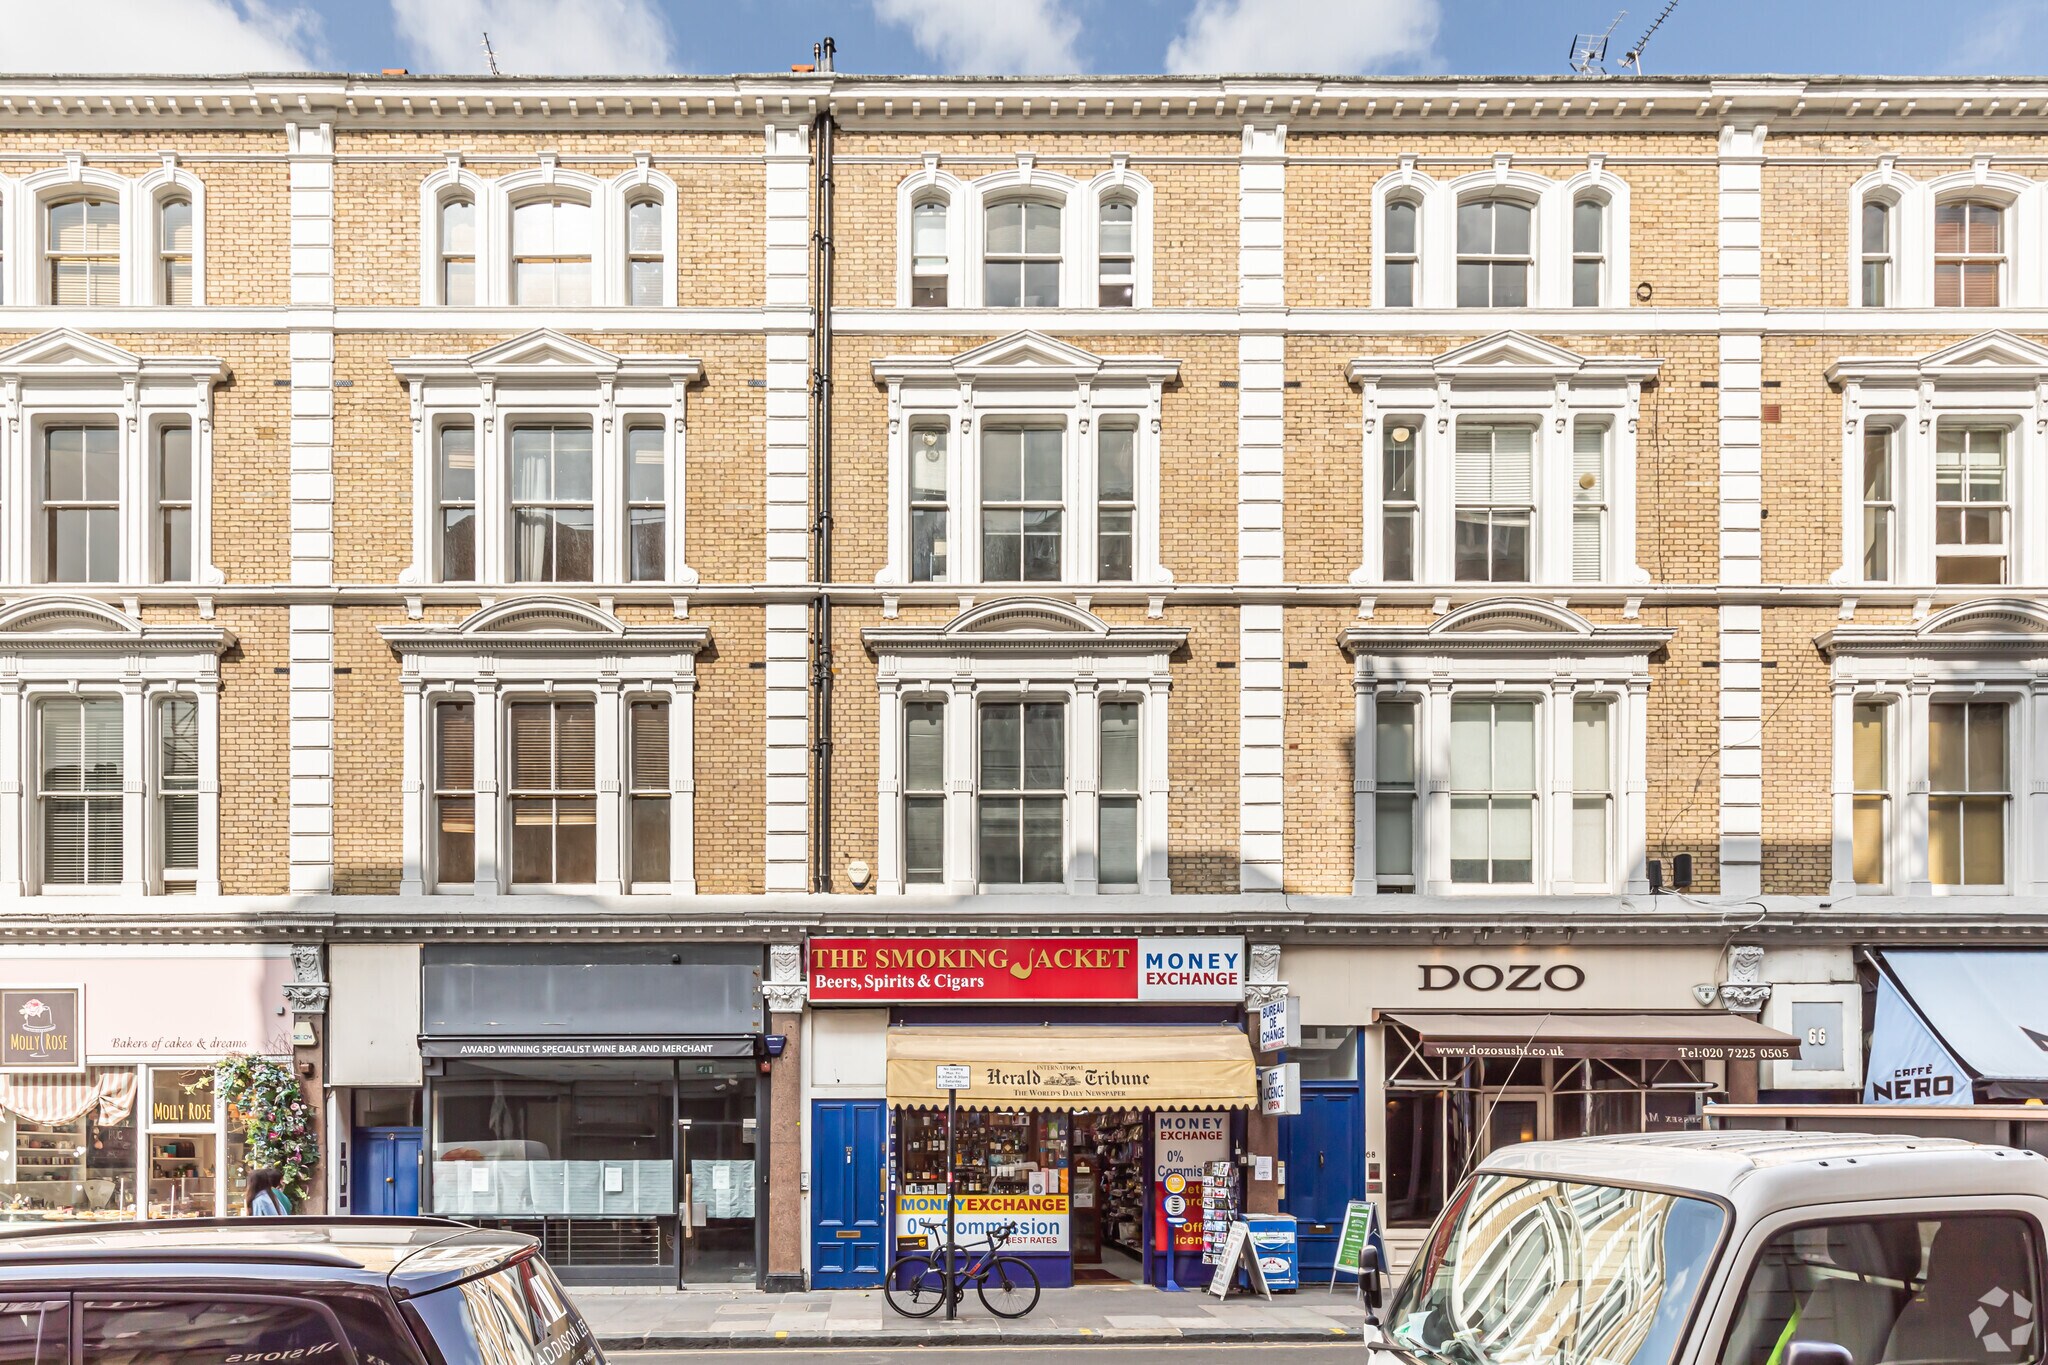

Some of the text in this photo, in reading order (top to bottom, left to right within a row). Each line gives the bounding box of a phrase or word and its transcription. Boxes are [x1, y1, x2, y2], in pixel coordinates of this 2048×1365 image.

[811, 948, 1130, 980] THE SMOKING JACKET
[1146, 953, 1238, 970] MONEY
[815, 974, 984, 992] Beers, Spirits & Cigars
[1146, 972, 1238, 985] EXCHANGE
[1418, 964, 1585, 992] DOZO
[1263, 1001, 1284, 1018] BUREAU
[1270, 1016, 1276, 1028] DE
[10, 1034, 68, 1050] MOLLY ROSE
[1262, 1027, 1284, 1043] CHANGE
[1808, 1028, 1826, 1046] 66
[111, 1037, 248, 1051] Bakers of cakes & dreams
[460, 1045, 496, 1054] AWARD
[498, 1045, 540, 1054] WINNING
[542, 1045, 590, 1053] SPECIALIST
[592, 1045, 616, 1053] WINE
[662, 1045, 713, 1053] MERCHANT
[1436, 1045, 1564, 1056] www.dozosushi.co.uk
[1678, 1048, 1788, 1058] Tel:020 7225 0505
[986, 1068, 1150, 1086] Herald Tribune
[1895, 1064, 1932, 1077] CAFFÈ
[1269, 1072, 1278, 1086] OFF
[1264, 1085, 1284, 1100] LICENCE
[1872, 1076, 1954, 1101] NERO
[154, 1102, 212, 1120] MOLLY ROSE
[1268, 1101, 1280, 1110] OPEN
[1160, 1118, 1222, 1129] MONEY
[1160, 1131, 1222, 1140] EXCHANGE
[1167, 1150, 1184, 1162] 0%
[968, 1199, 1066, 1210] EXCHANGE
[575, 1318, 588, 1338] LEE
